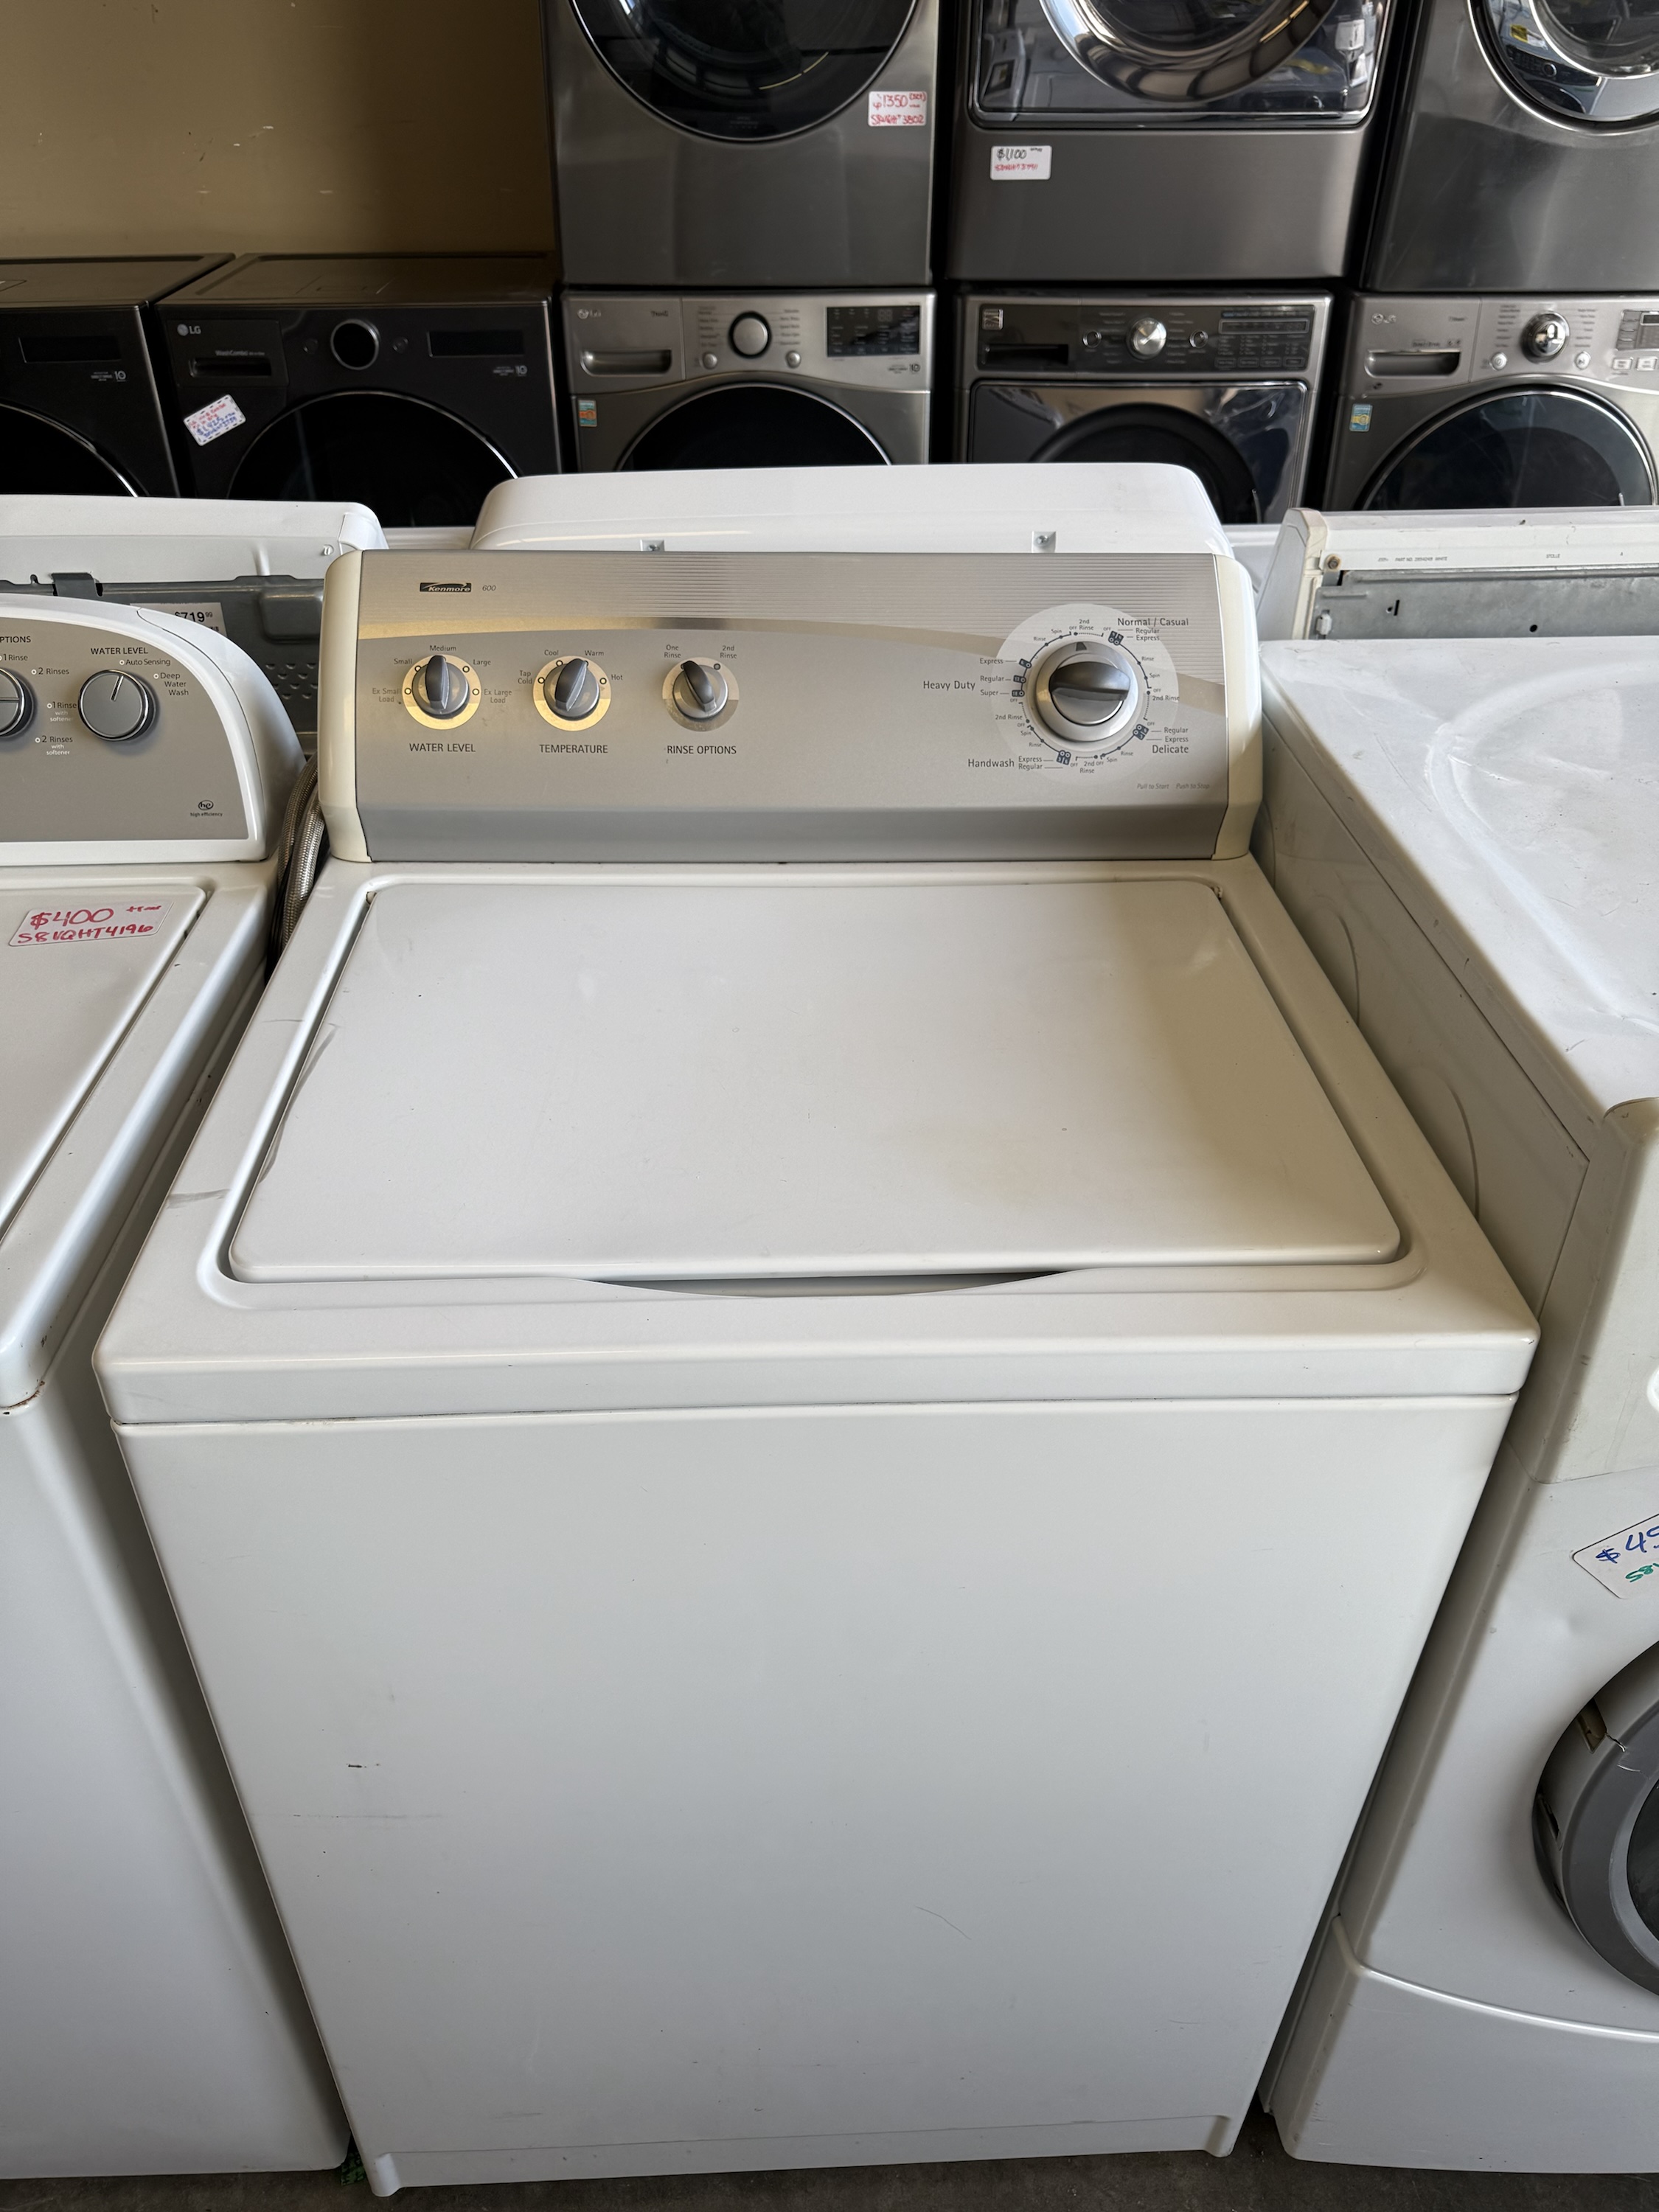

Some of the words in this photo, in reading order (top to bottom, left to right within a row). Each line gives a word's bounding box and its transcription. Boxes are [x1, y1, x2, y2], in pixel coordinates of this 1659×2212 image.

[1118, 618, 1150, 626] Normal
[1160, 618, 1189, 626] Casual
[144, 658, 171, 667] Sensing
[160, 672, 181, 681] Deep
[923, 681, 950, 691] Heavy
[954, 681, 975, 690] Duty
[409, 743, 443, 751] WATER
[448, 744, 476, 752] LEVEL
[540, 745, 608, 753] TEMPERATURE
[667, 745, 694, 754] RINSE
[697, 745, 737, 754] OPTIONS
[1152, 745, 1189, 754] Delicate
[968, 759, 1015, 768] Handwash
[30, 908, 114, 930] $400
